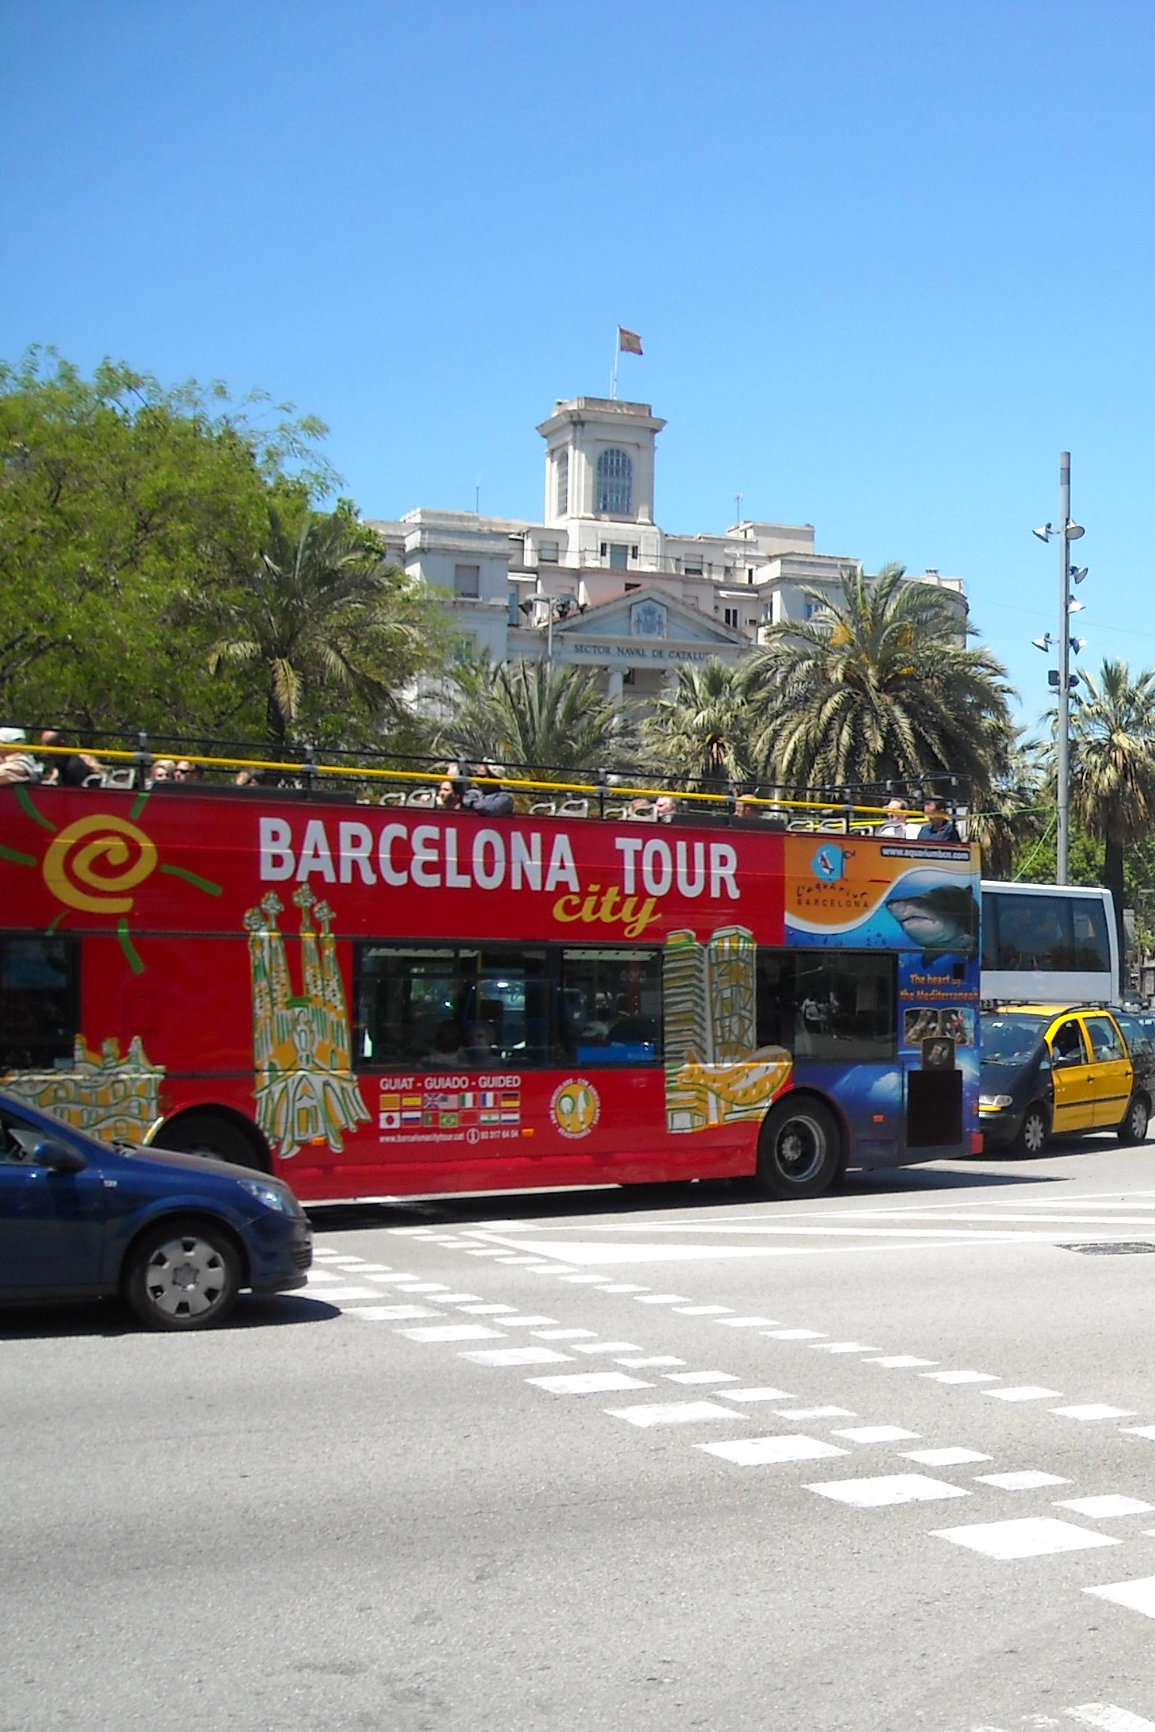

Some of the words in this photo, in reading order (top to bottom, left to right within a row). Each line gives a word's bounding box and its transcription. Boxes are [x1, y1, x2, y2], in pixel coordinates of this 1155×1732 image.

[573, 644, 611, 655] SECTOR
[616, 647, 647, 658] NAVAL
[652, 650, 665, 659] DE
[259, 816, 579, 892] BARCELONA
[615, 836, 740, 899] TOUR
[881, 847, 969, 860] www.aquariumbcn.com
[552, 883, 662, 938] city
[796, 898, 869, 908] BARCELONA
[379, 1077, 415, 1091] GUIAT
[424, 1076, 469, 1089] GUIADO
[478, 1075, 521, 1088] GUIDED
